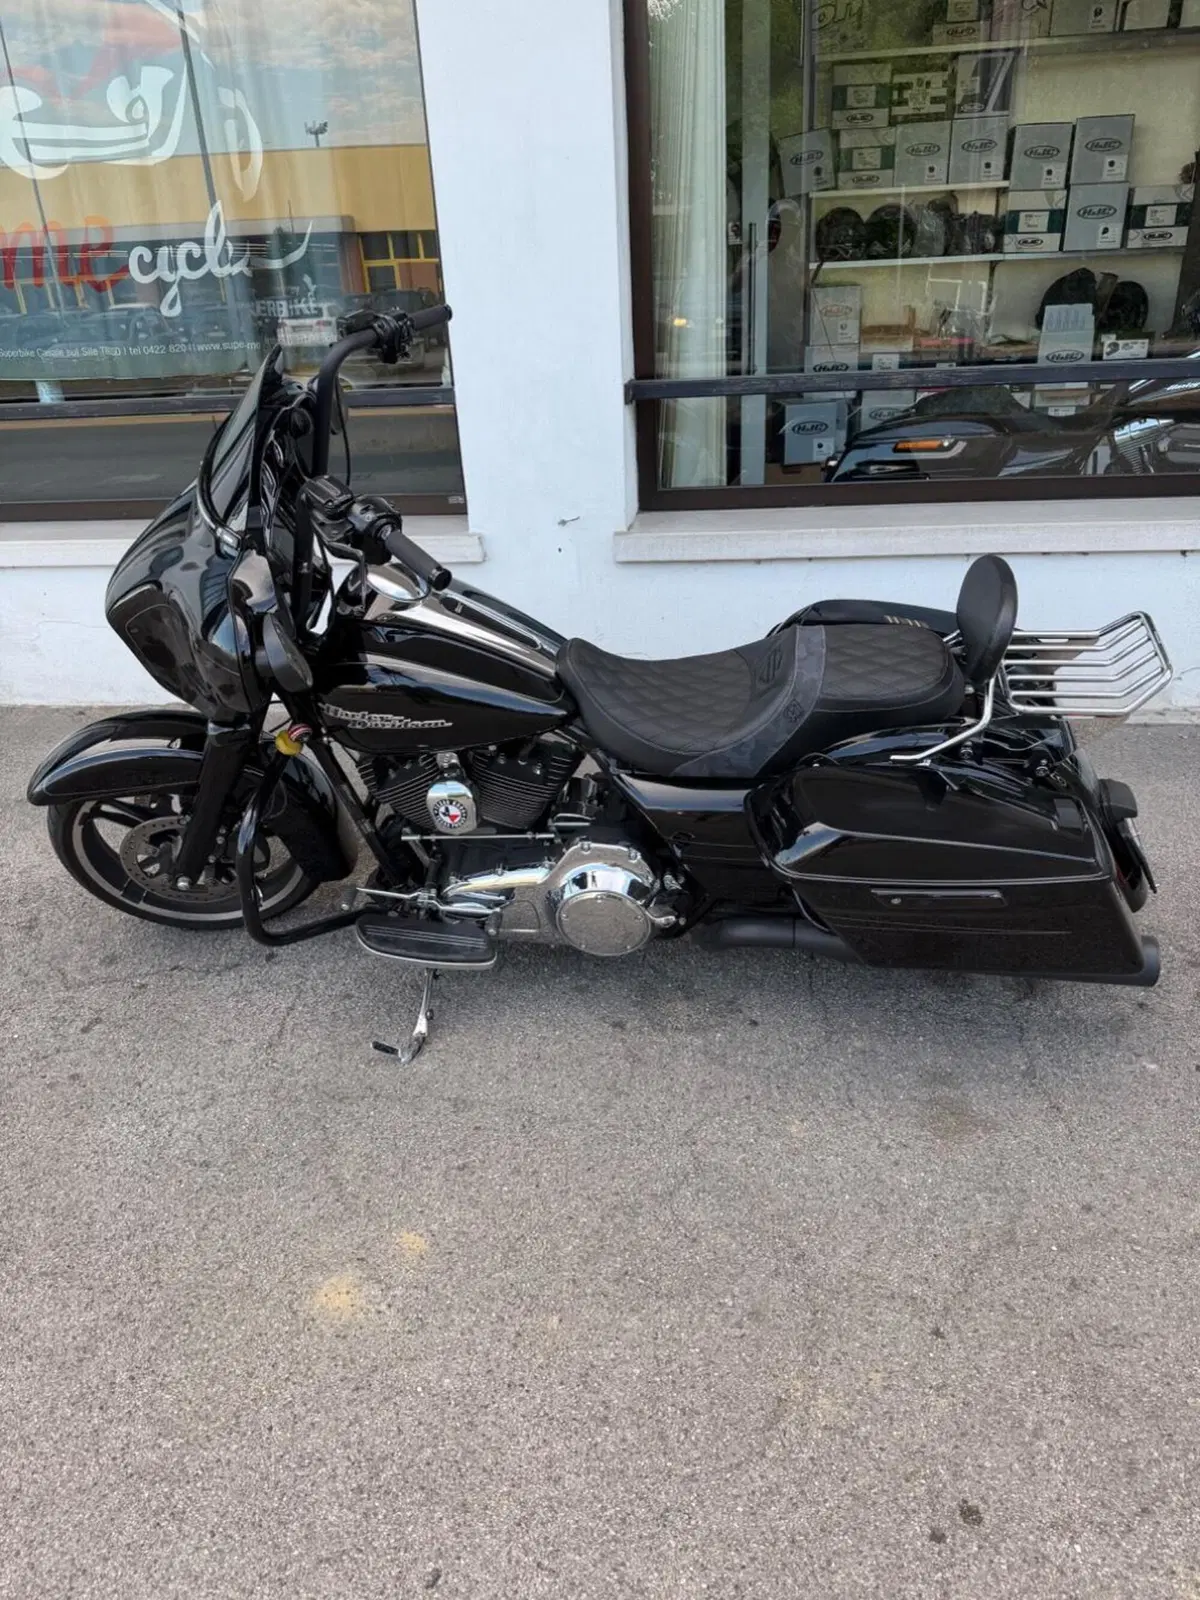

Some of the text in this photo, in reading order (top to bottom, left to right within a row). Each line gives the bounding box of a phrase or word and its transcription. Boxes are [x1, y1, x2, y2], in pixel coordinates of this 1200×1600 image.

[966, 140, 995, 151] HJC
[1090, 140, 1118, 150] HJC
[1029, 147, 1056, 157] HJC
[1083, 206, 1113, 217] HJC
[143, 345, 166, 354] 0422
[1050, 351, 1081, 362] HJC
[817, 363, 845, 372] HJC
[797, 423, 825, 433] HJC
